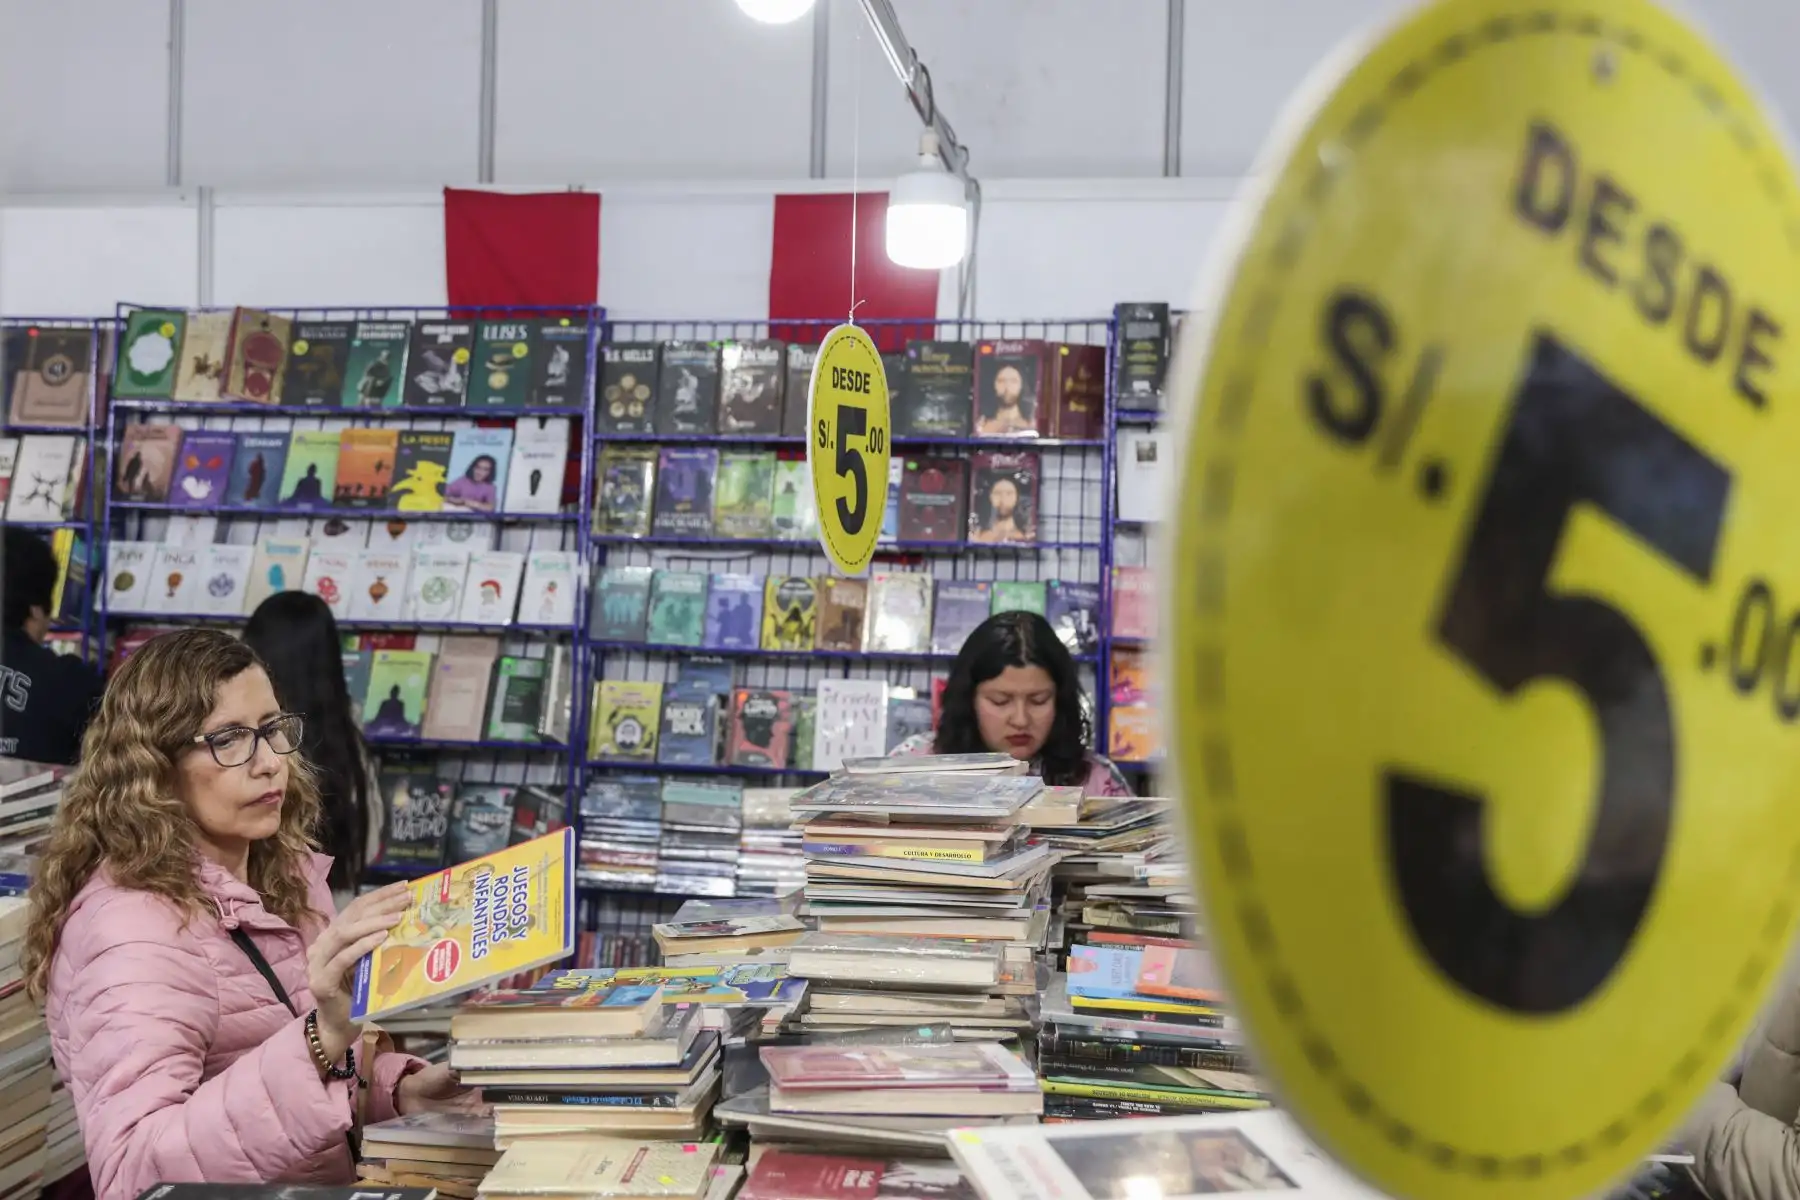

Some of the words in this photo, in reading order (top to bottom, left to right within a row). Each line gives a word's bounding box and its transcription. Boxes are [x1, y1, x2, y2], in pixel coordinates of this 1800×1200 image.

[1512, 115, 1783, 411] DESDE
[832, 365, 870, 395] DESDE
[1307, 284, 1450, 503] S/.
[818, 418, 834, 449] S/.
[835, 404, 868, 536] 5
[865, 426, 884, 455] .00
[163, 551, 196, 565] INCA
[1377, 324, 1735, 1024] 5
[934, 852, 972, 860] DESARROLLO
[472, 872, 490, 959] INFANTILES
[492, 875, 509, 942] RONDAS
[512, 866, 528, 926] JUEGOS
[512, 929, 527, 939] Y
[507, 1094, 524, 1102] VEGA
